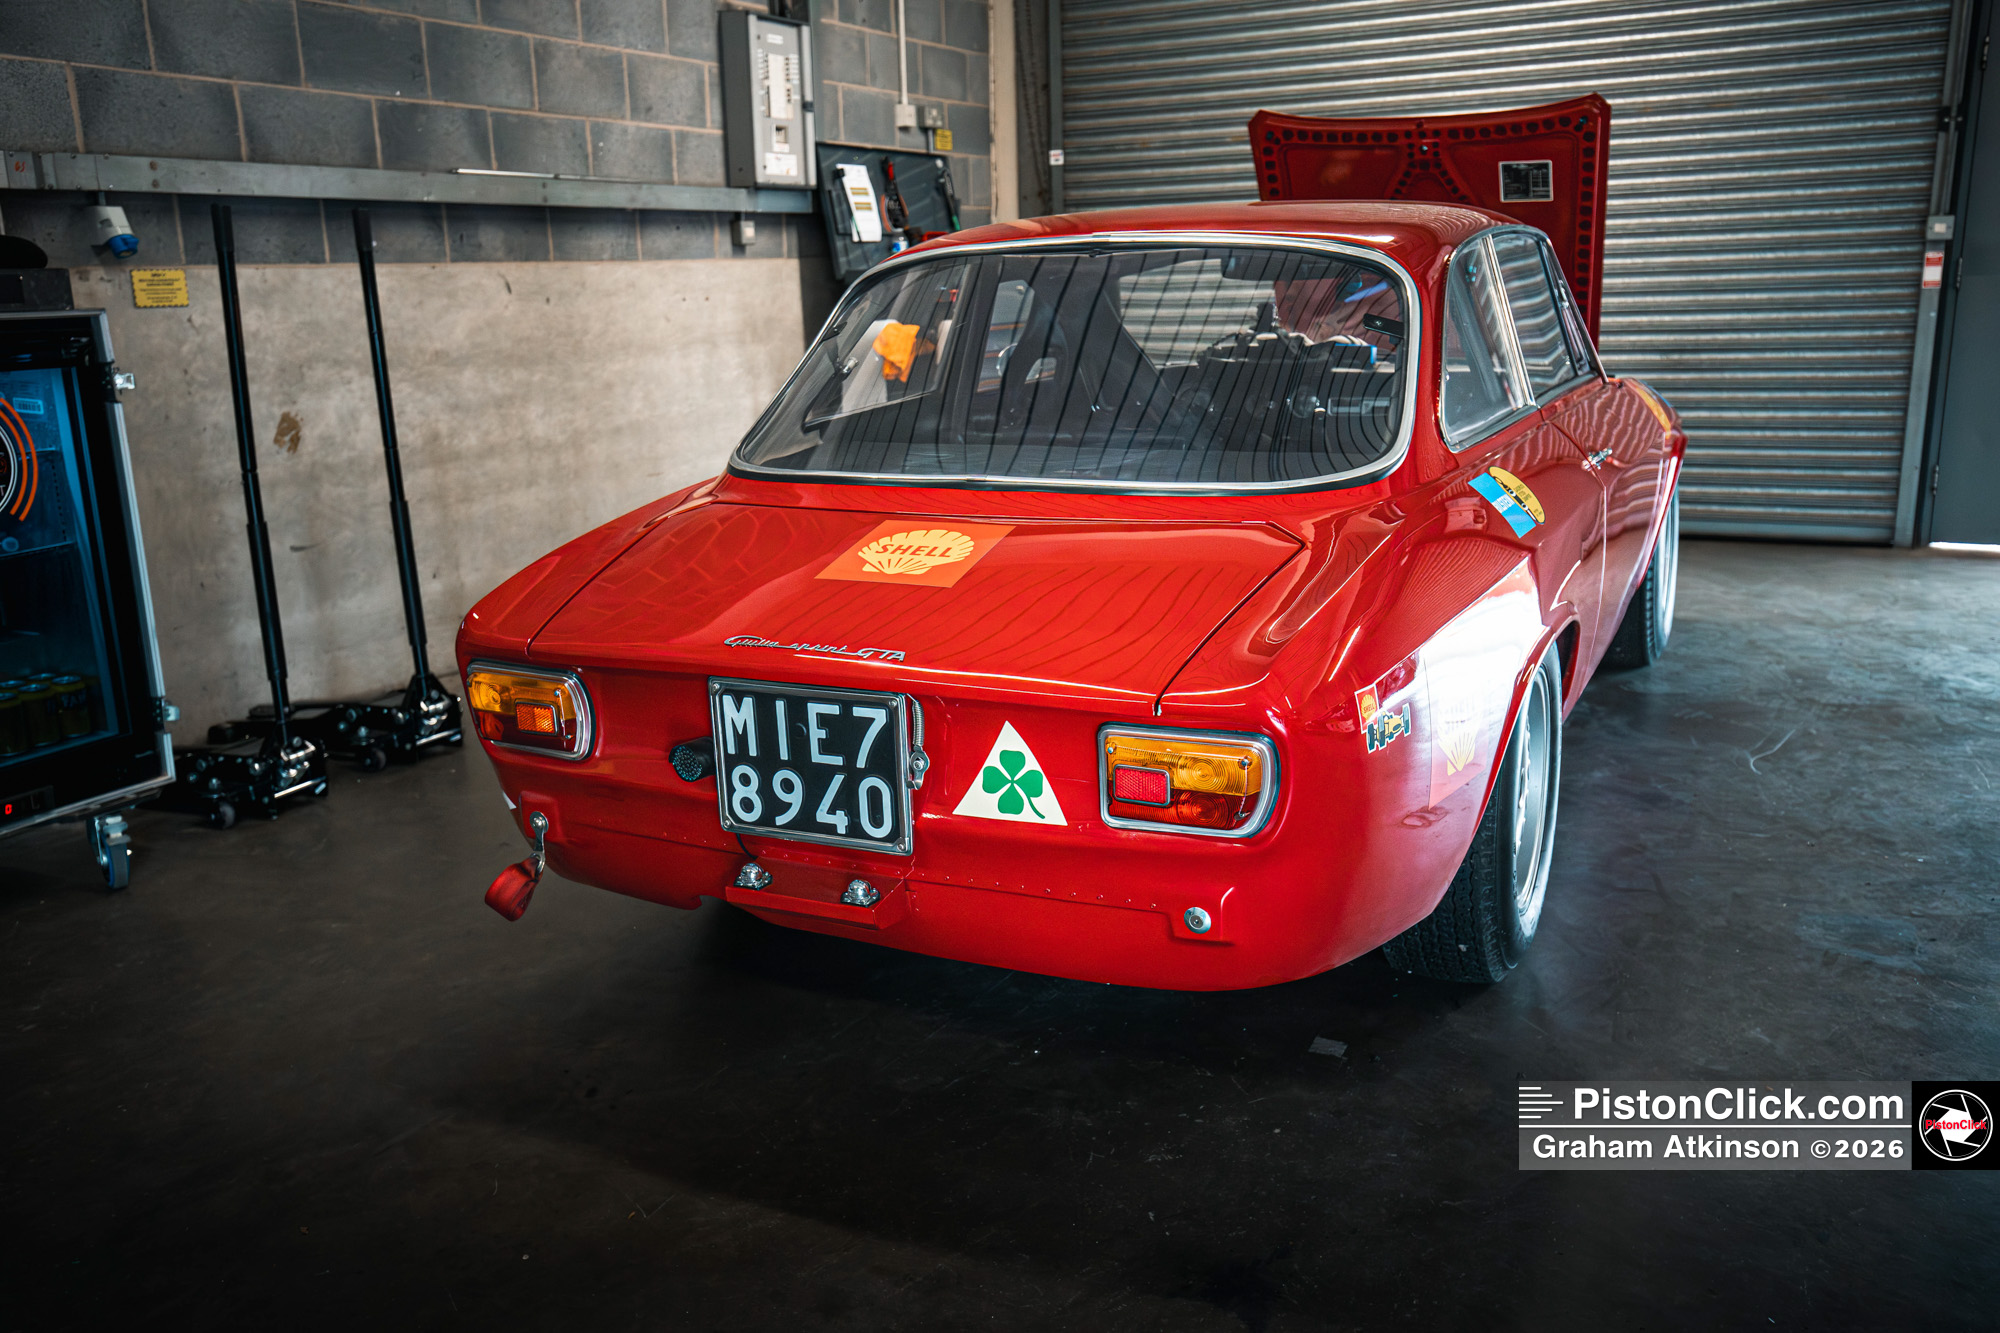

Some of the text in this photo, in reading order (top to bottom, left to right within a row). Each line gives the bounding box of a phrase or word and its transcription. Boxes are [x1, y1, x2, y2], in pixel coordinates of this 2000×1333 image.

[875, 542, 953, 558] SHELL
[857, 647, 906, 662] GTA
[1363, 703, 1375, 714] SHELL
[730, 764, 893, 839] 8940
